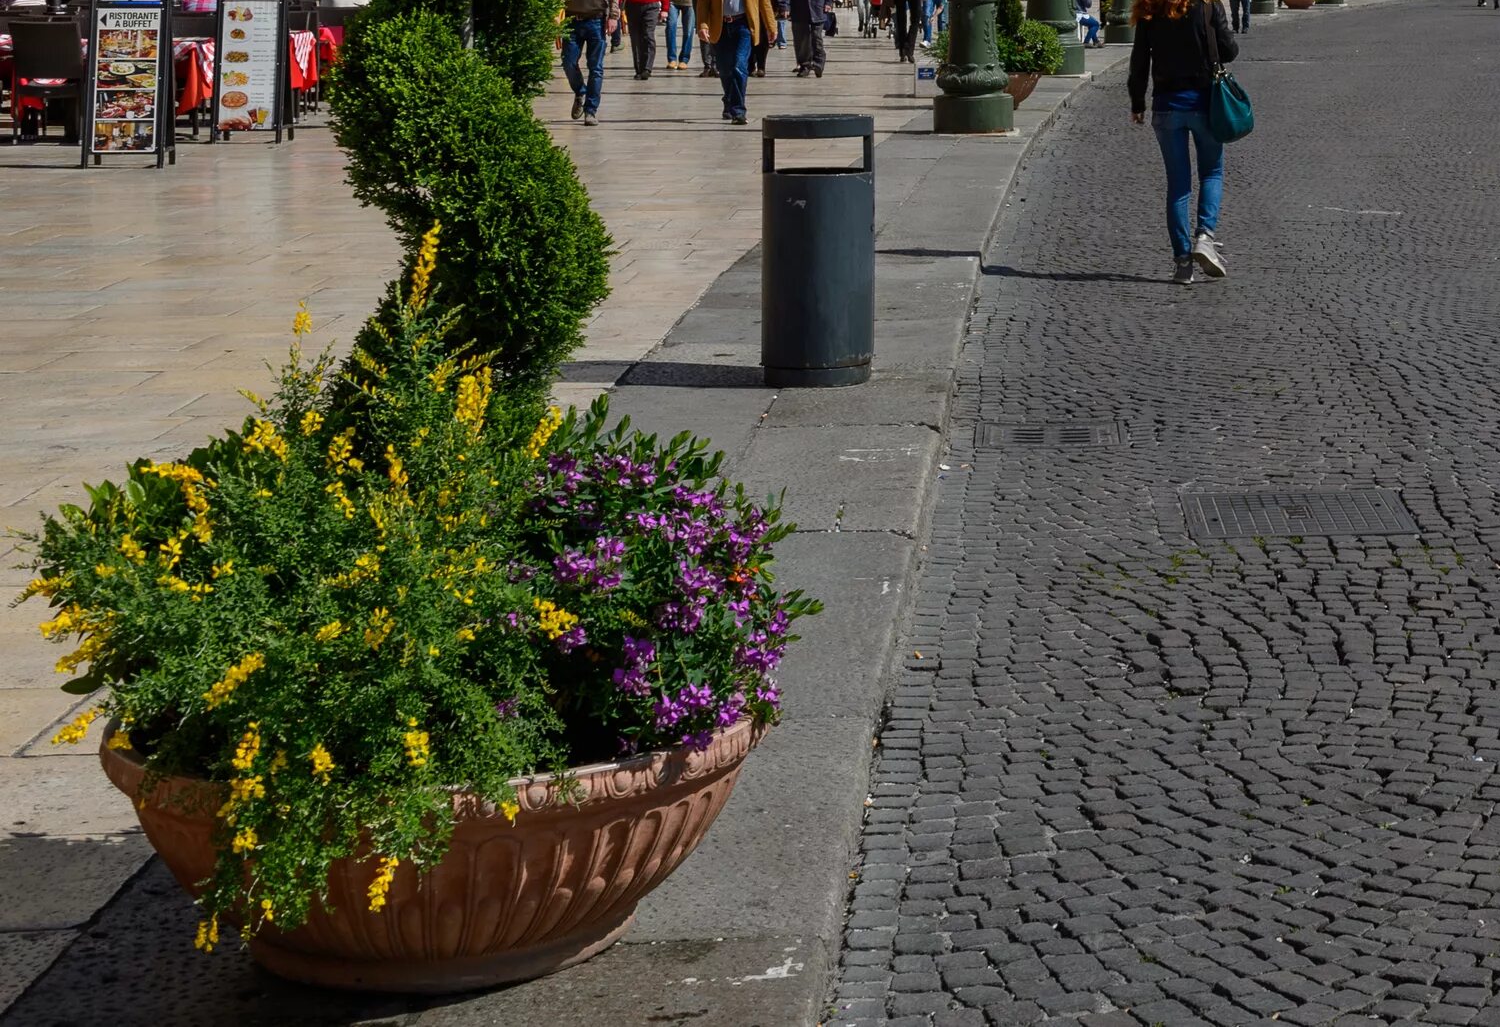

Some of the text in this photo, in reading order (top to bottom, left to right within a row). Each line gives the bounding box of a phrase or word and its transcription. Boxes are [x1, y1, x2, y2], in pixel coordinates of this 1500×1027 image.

[109, 11, 158, 20] RISTORANTE
[114, 19, 152, 28] A BUFFET
